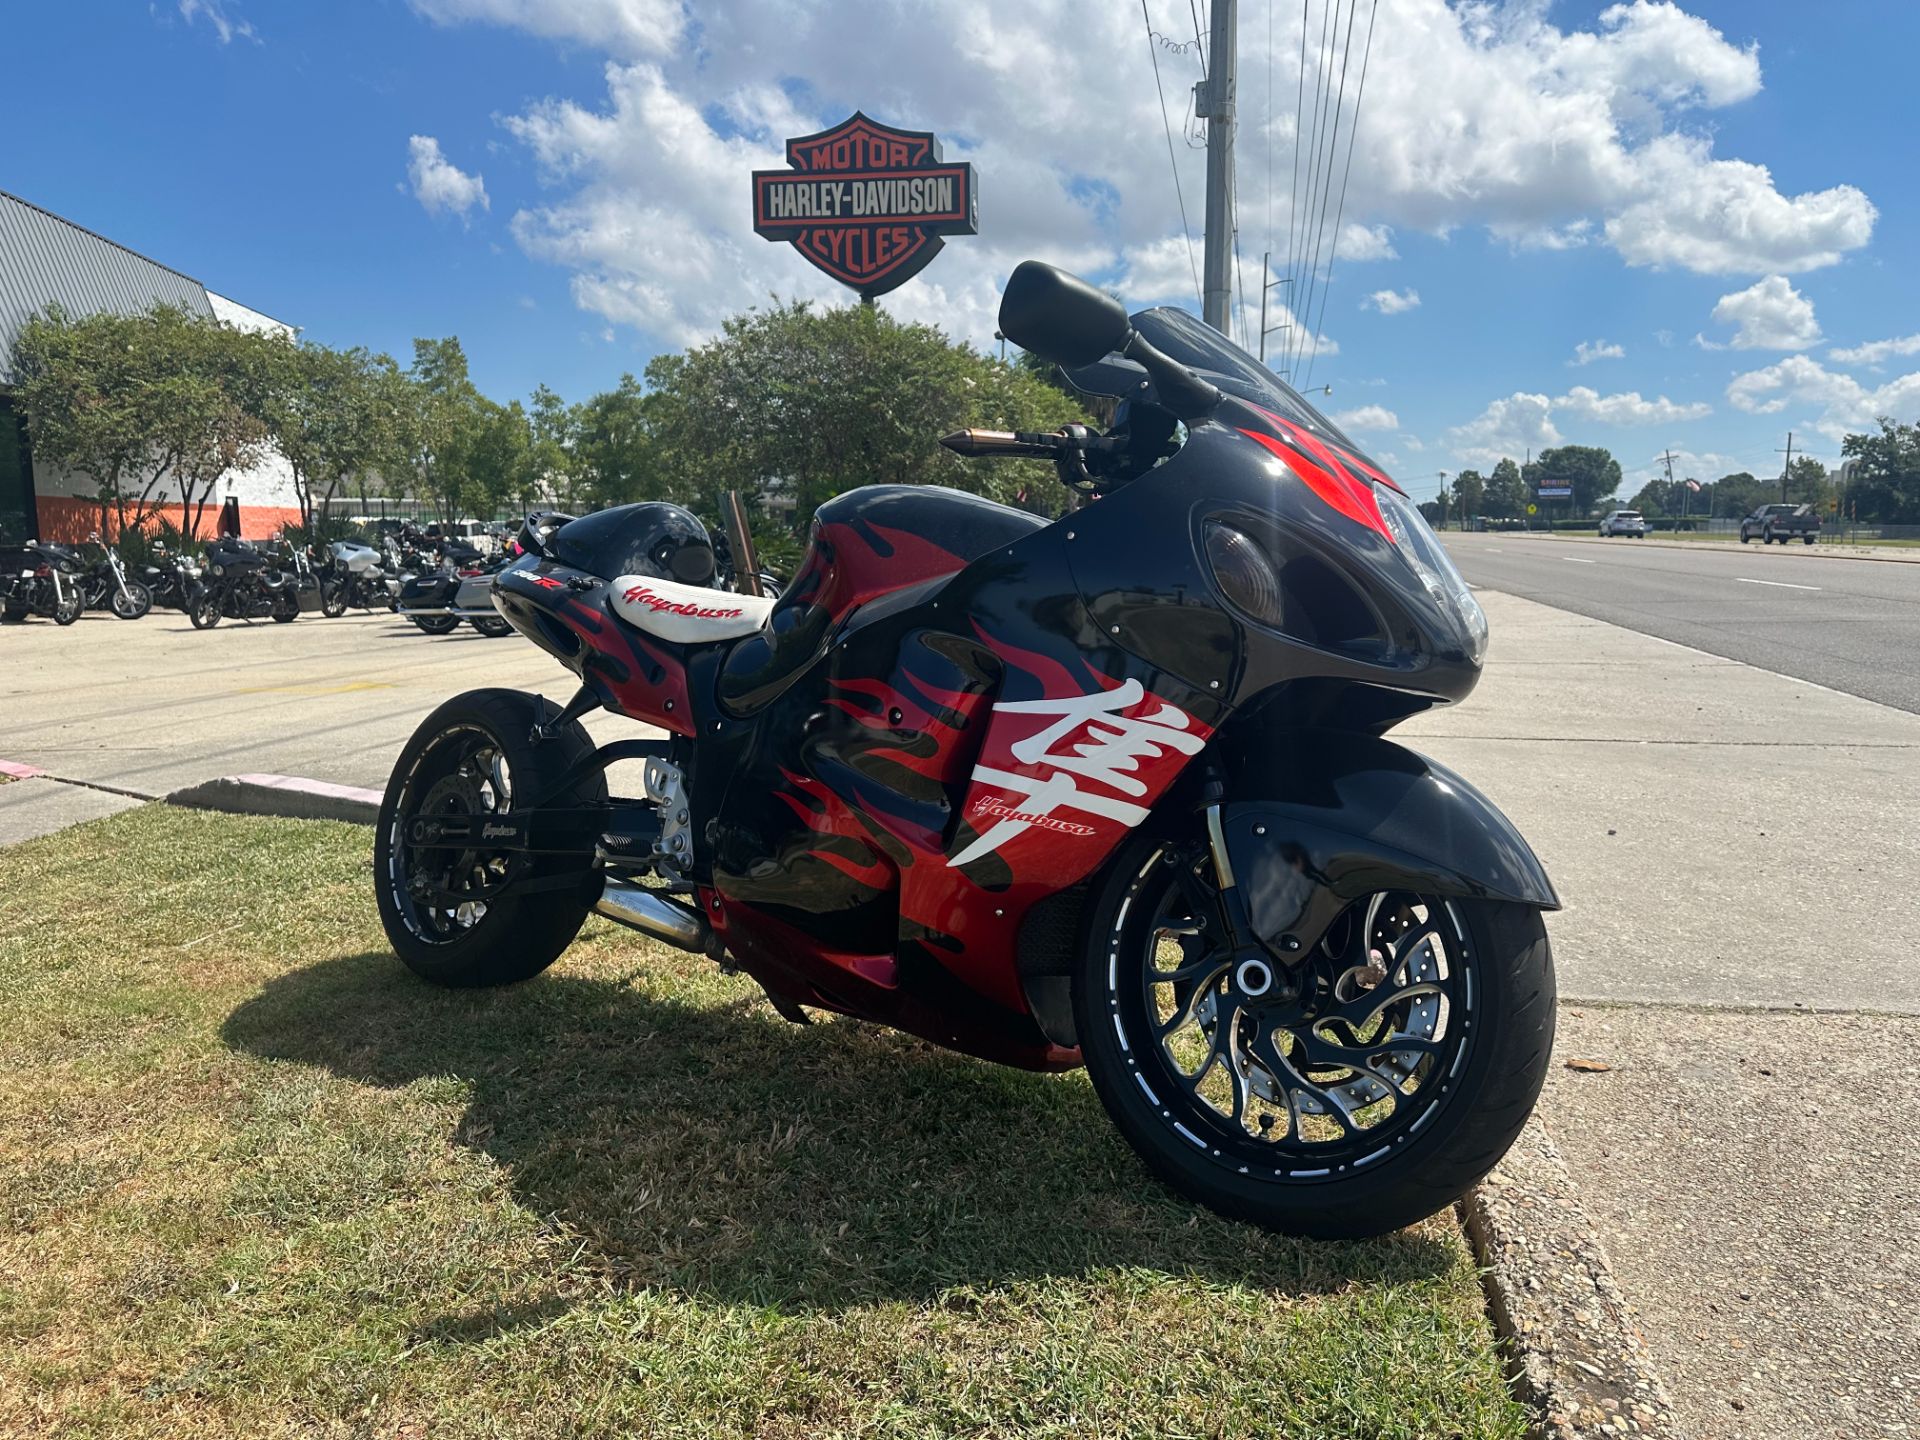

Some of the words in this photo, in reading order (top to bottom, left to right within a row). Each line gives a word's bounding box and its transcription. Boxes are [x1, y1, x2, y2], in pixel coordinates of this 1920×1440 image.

[811, 130, 909, 170] MOTOR
[769, 177, 953, 218] HARLEY-DAVIDSON
[812, 226, 909, 274] CYCLES
[622, 585, 743, 618] Hayabusa
[972, 795, 1096, 836] Hayabusa
